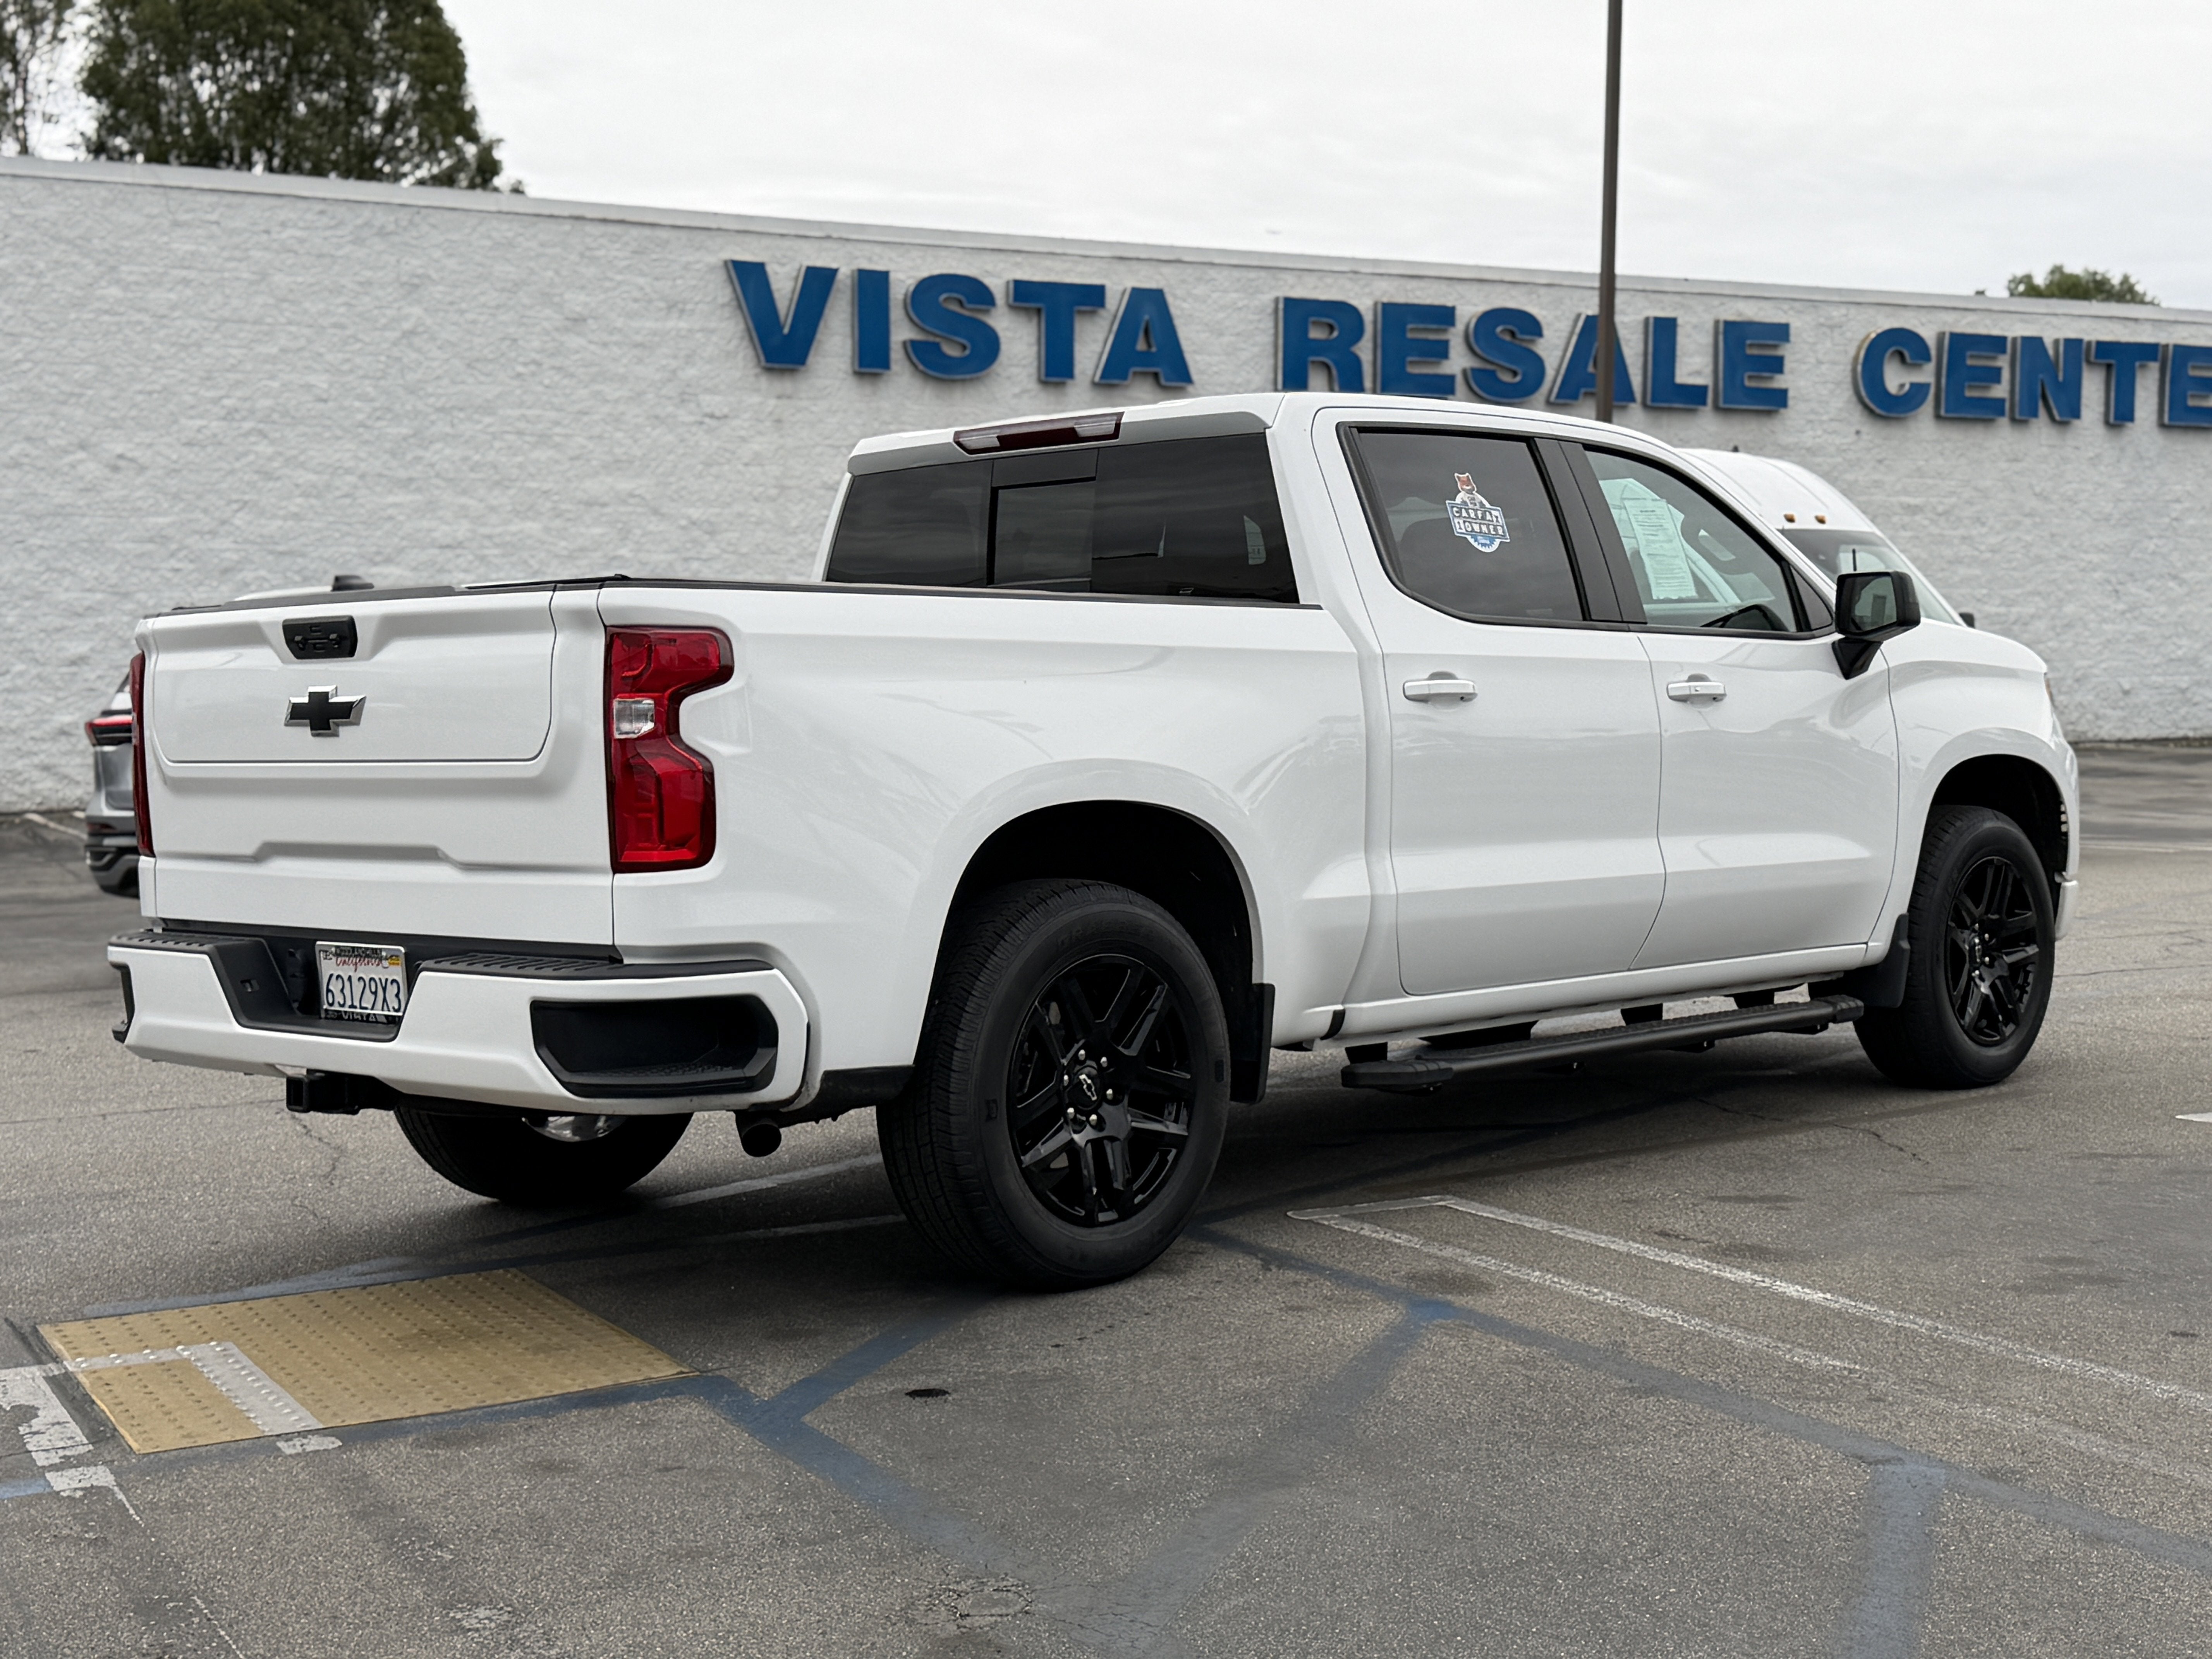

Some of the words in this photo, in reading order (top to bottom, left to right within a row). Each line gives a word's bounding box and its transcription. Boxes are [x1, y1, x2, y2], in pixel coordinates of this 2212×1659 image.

[725, 259, 1194, 386] VISTA
[1275, 296, 1790, 409] RESALE
[1853, 327, 2212, 426] CENTE
[1453, 507, 1501, 524] CARFAX
[1465, 522, 1504, 535] OWNER
[326, 973, 402, 1013] 63129X3
